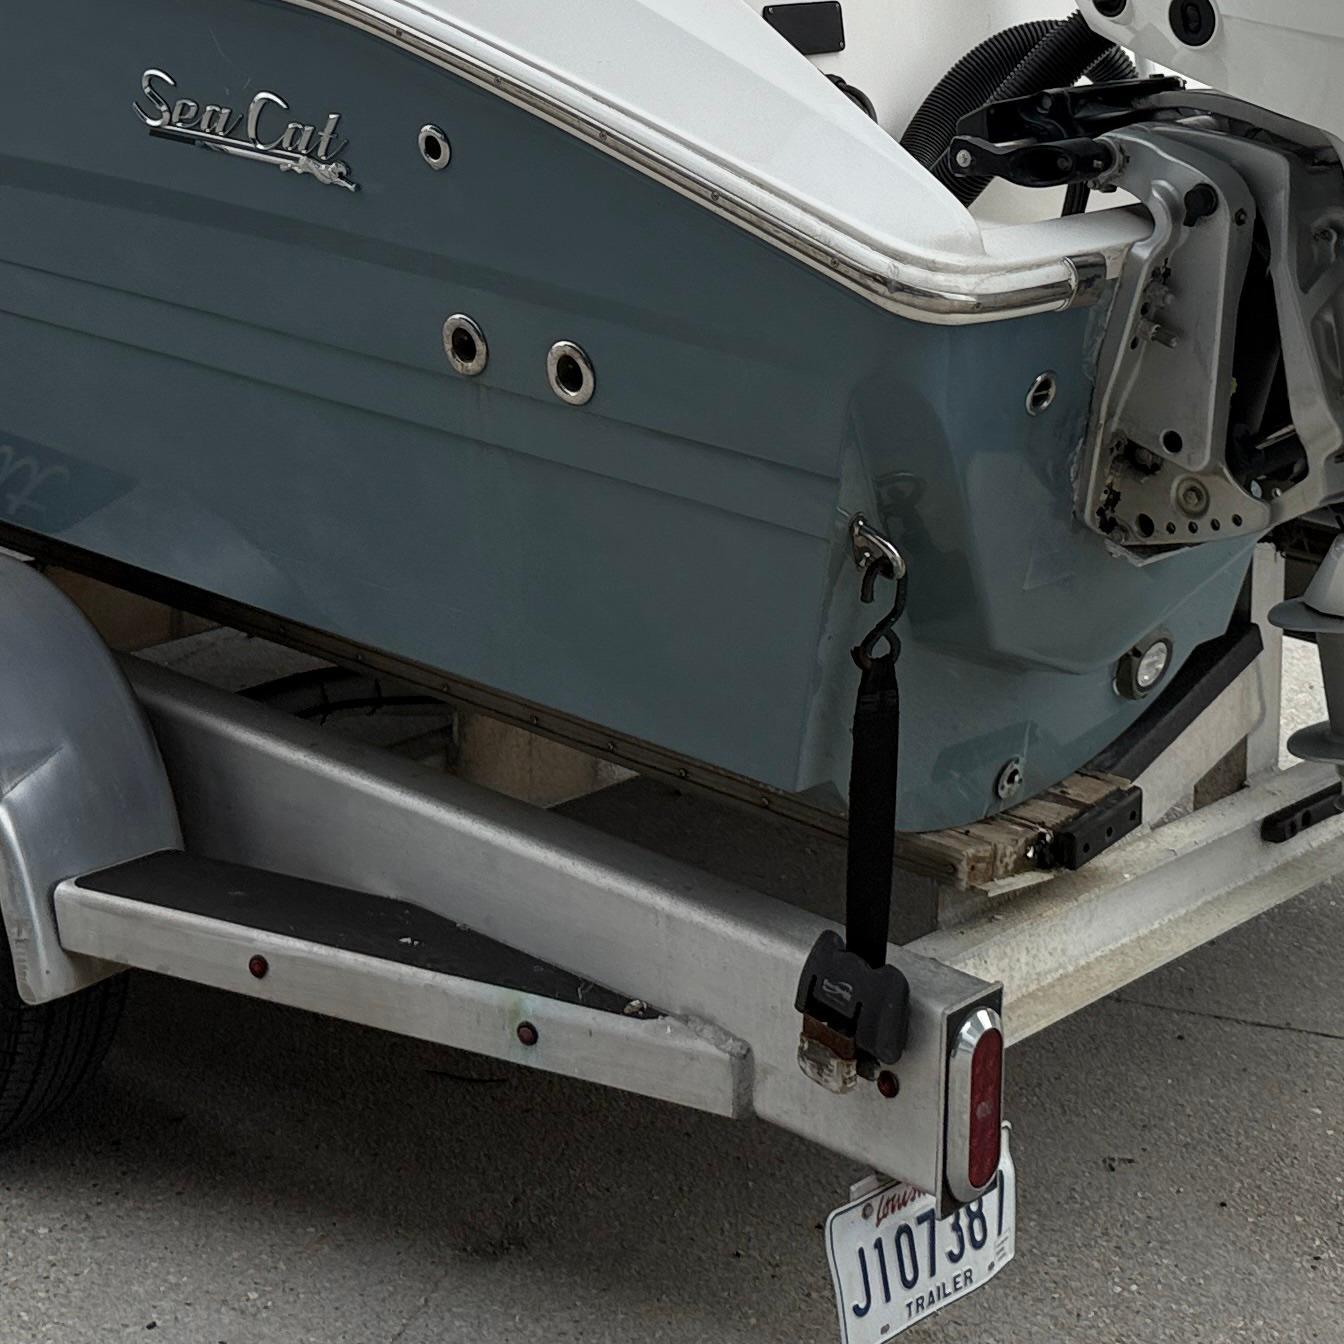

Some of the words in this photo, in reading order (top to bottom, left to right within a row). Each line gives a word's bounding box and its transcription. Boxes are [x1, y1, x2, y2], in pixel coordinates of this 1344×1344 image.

[131, 67, 243, 137] Sea
[246, 90, 350, 162] Cat
[904, 1268, 975, 1320] TRAILER
